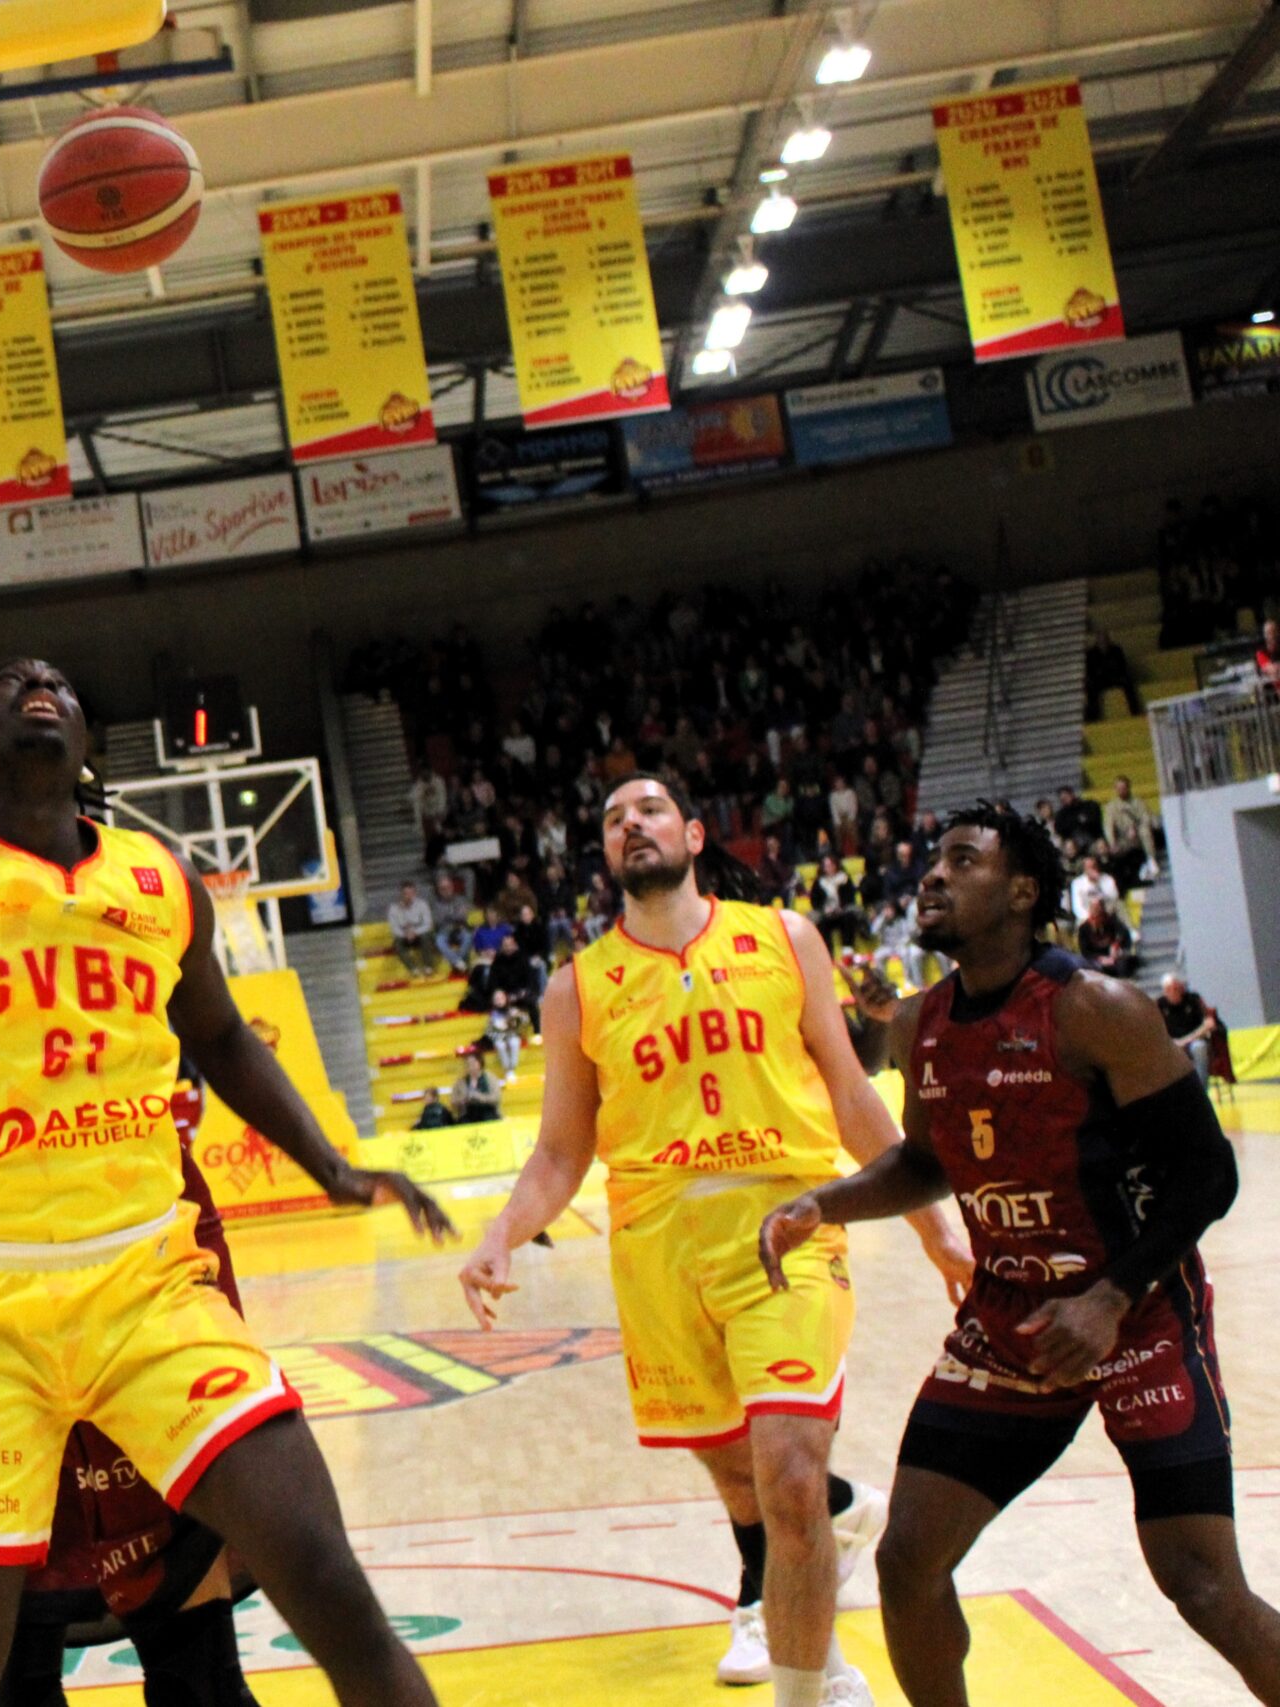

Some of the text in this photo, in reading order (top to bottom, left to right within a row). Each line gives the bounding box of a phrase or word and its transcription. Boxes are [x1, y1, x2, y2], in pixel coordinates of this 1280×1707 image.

[205, 490, 291, 544] Sportive
[42, 1027, 107, 1079] 61
[632, 1008, 765, 1084] SVBD
[699, 1072, 722, 1117] 6
[968, 1108, 996, 1161] 5
[1116, 1384, 1186, 1412] CARTE
